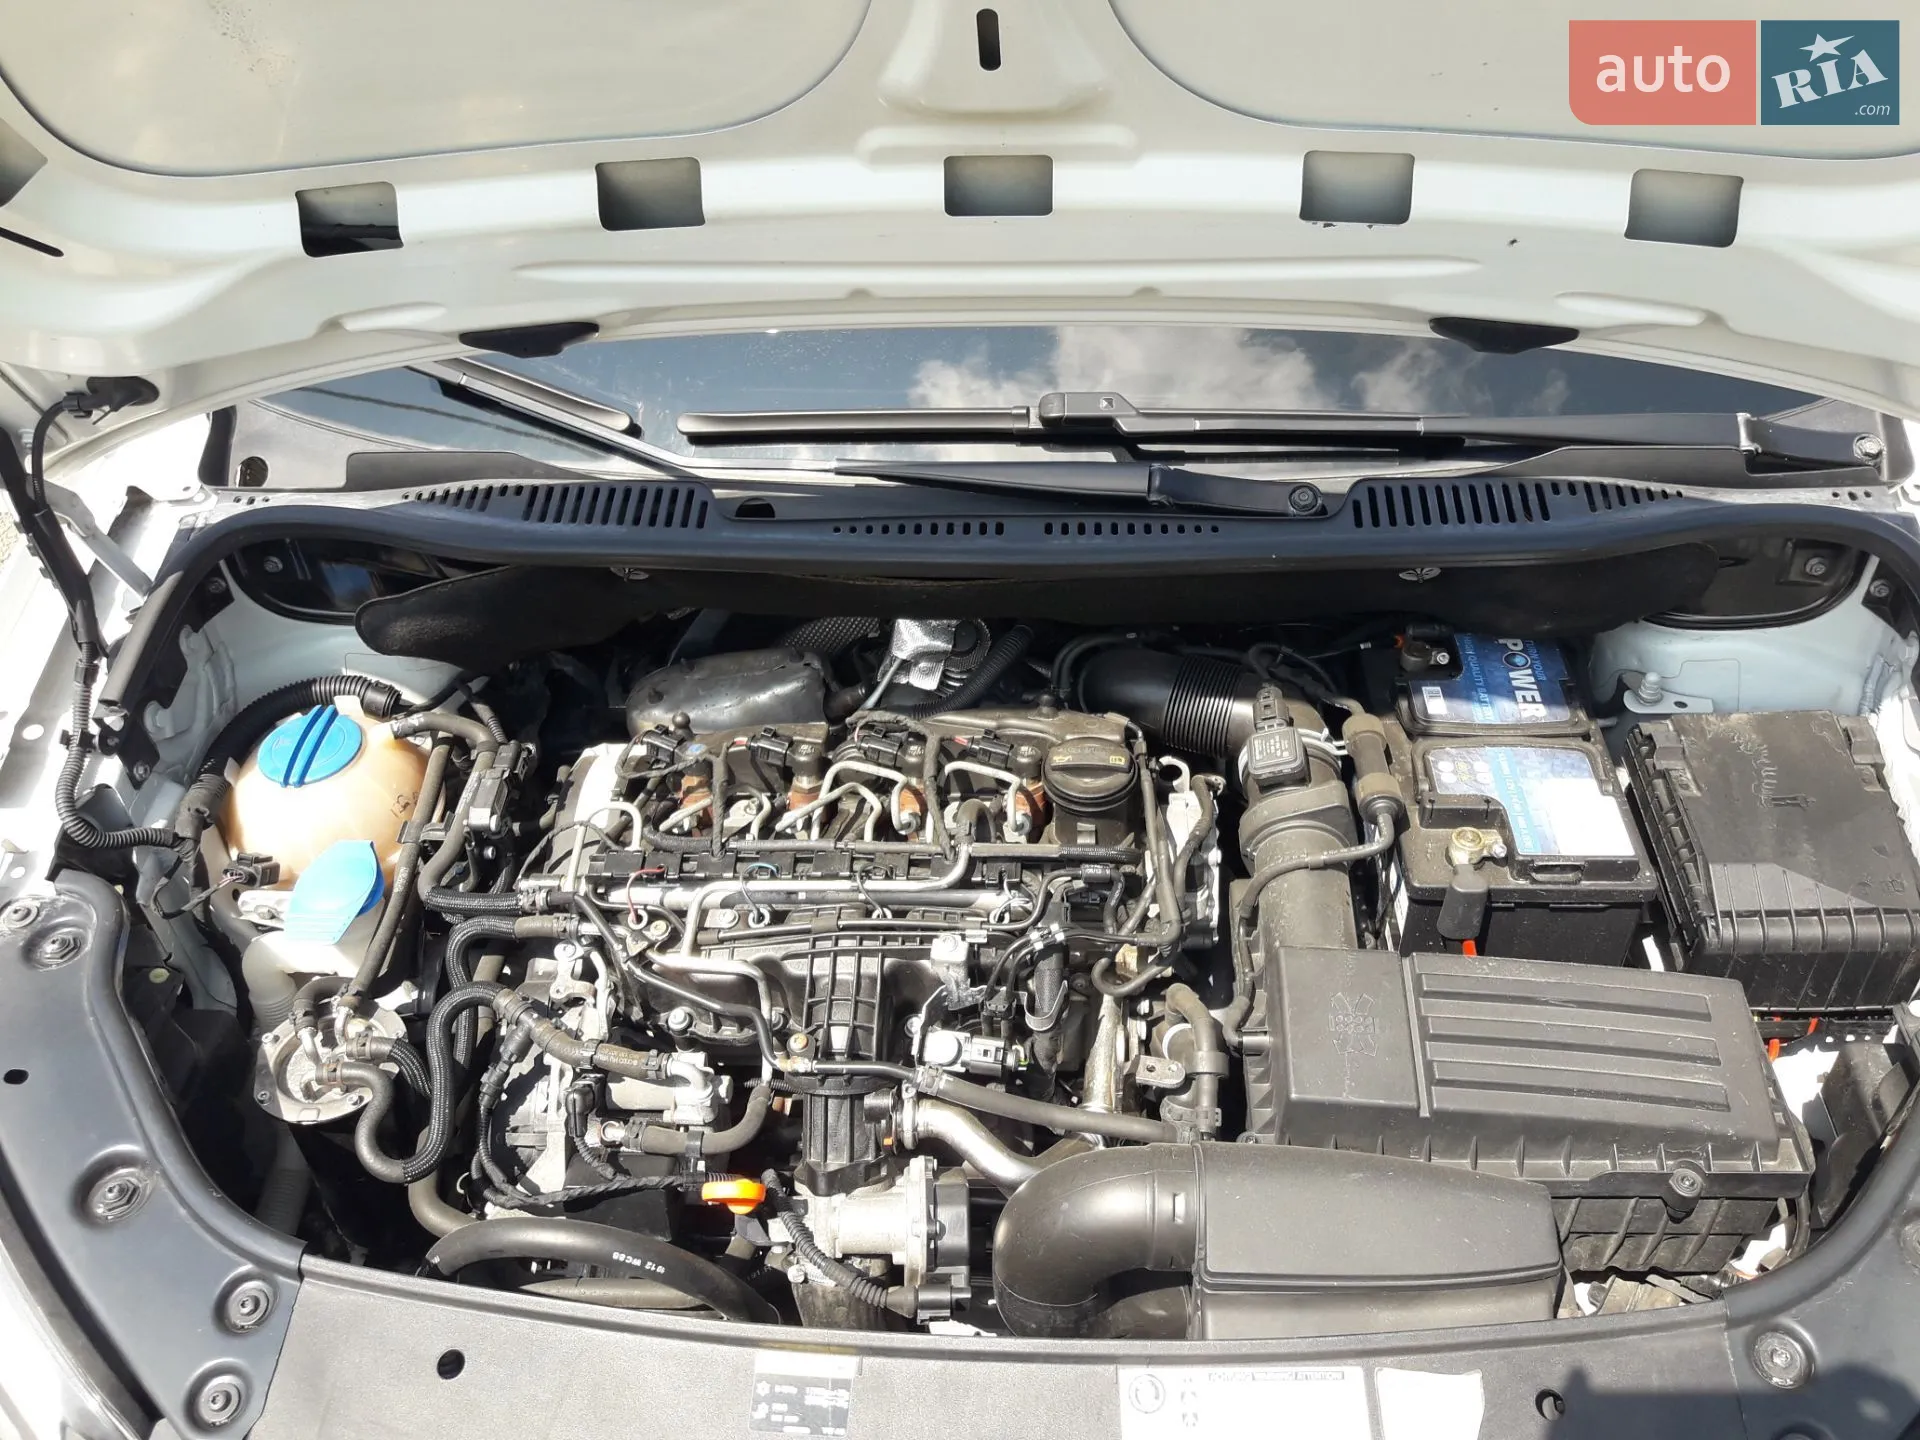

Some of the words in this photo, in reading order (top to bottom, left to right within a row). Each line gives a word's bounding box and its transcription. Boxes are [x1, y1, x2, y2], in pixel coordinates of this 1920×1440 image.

[1467, 653, 1485, 687] QUALITY
[1476, 686, 1495, 721] BATTERY
[1498, 638, 1548, 719] POWER
[1524, 640, 1540, 660] TURN
[1532, 659, 1547, 681] YOUR
